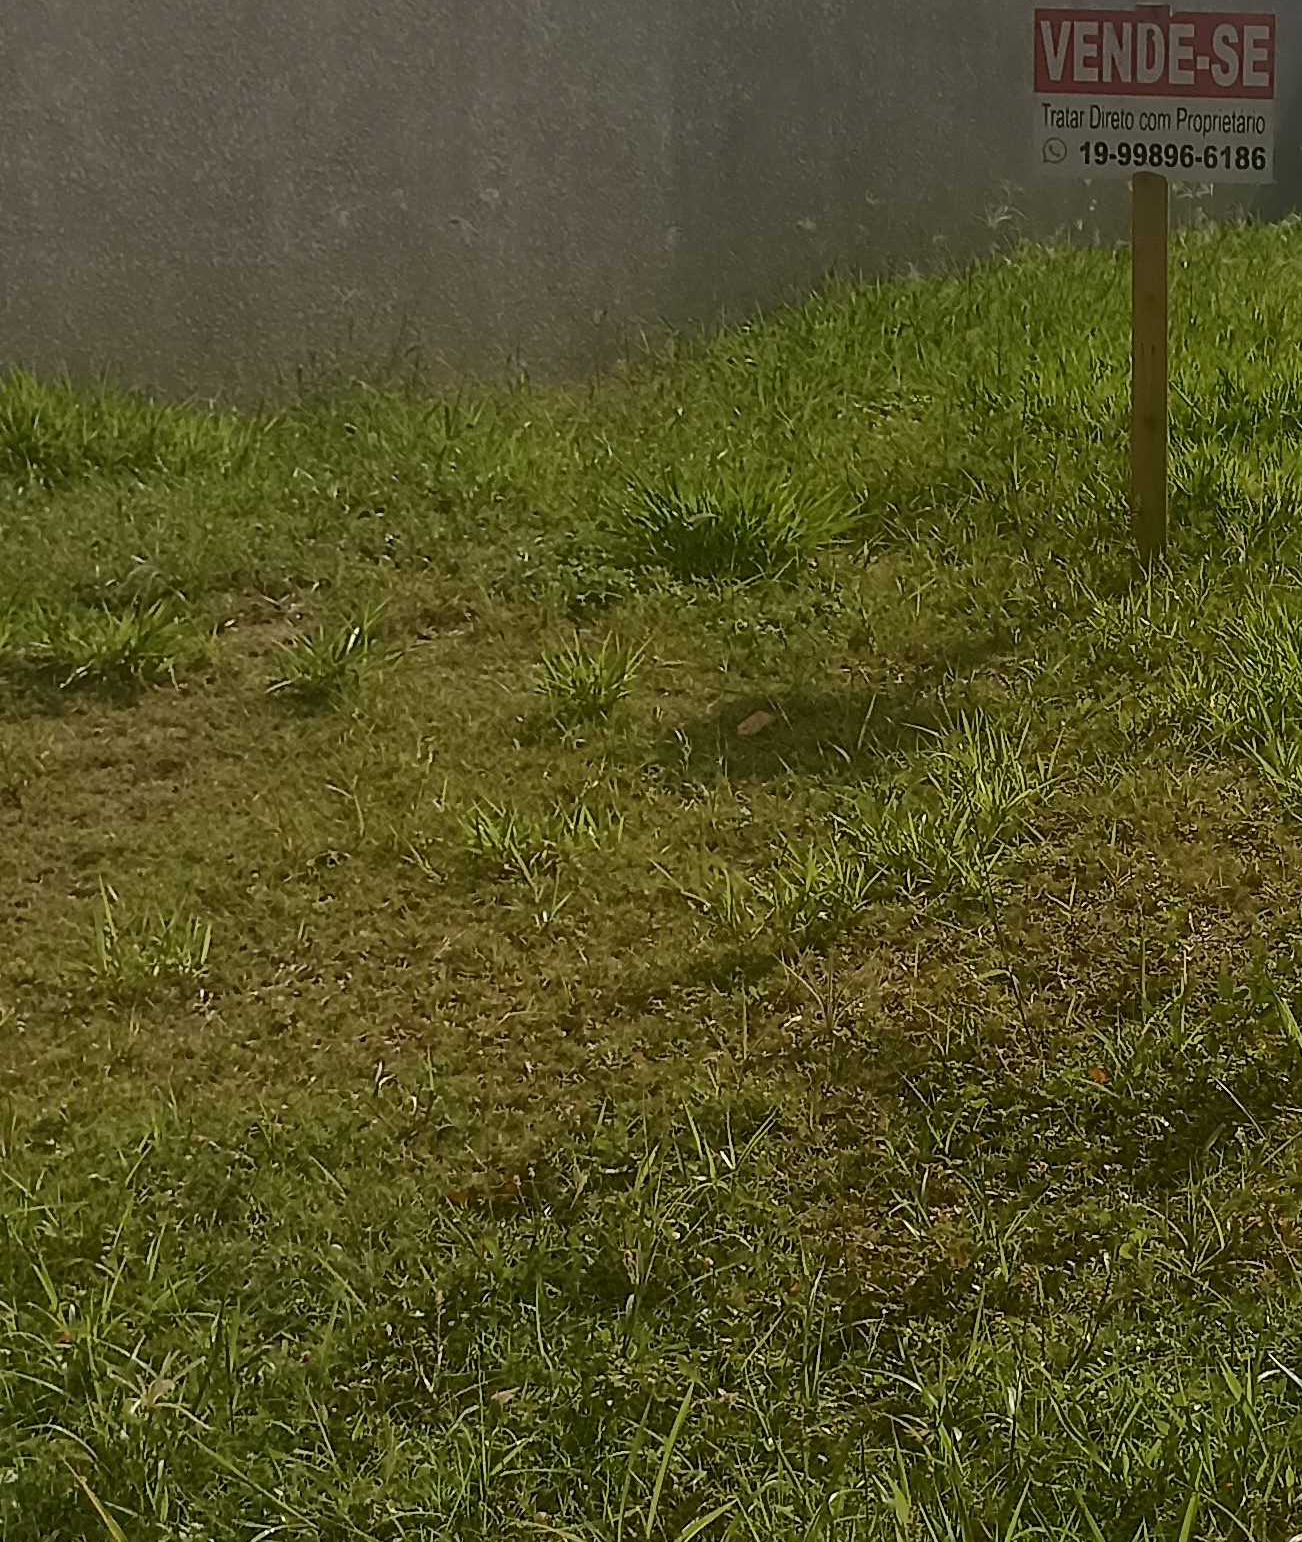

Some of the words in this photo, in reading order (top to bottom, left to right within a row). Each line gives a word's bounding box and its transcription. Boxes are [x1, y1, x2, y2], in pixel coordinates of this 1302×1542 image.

[1040, 20, 1270, 87] VENDE-SE
[1042, 102, 1085, 129] Tratar
[1089, 104, 1134, 131] Direto
[1139, 111, 1171, 131] com
[1080, 141, 1267, 170] 19-99896-6186
